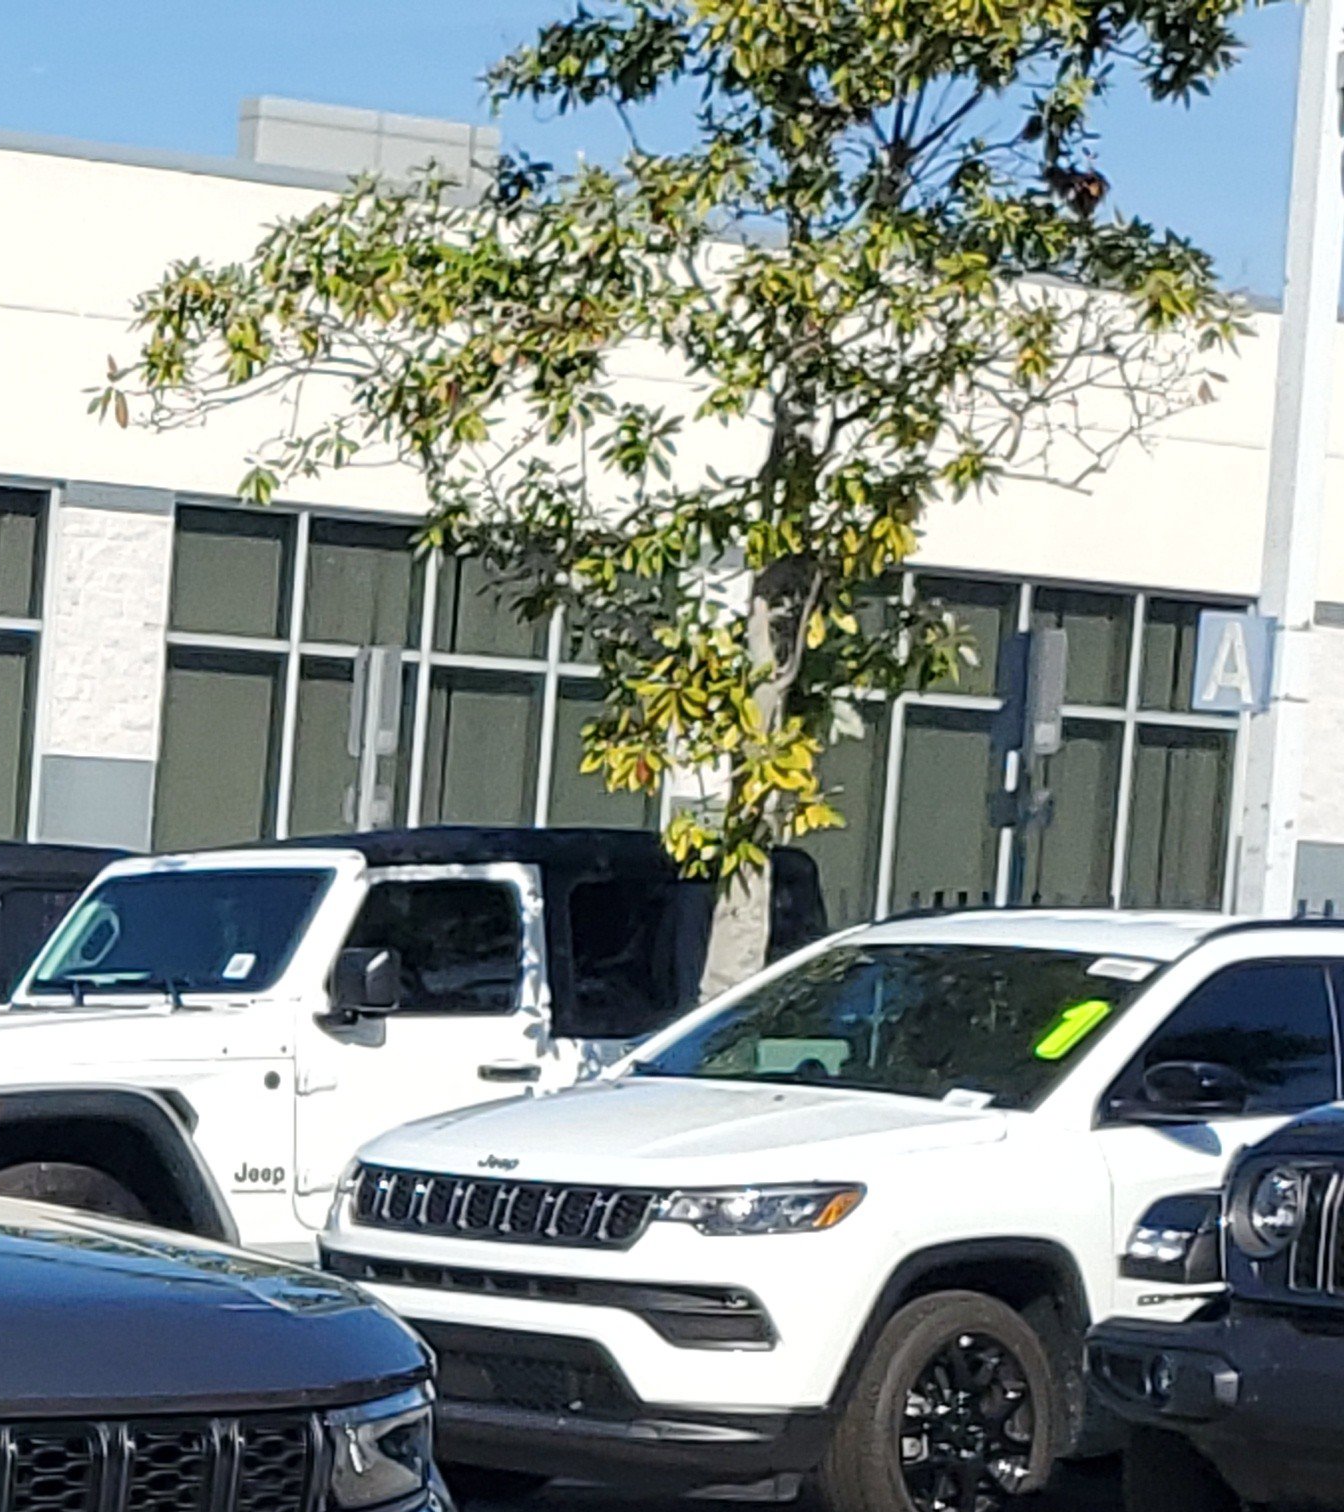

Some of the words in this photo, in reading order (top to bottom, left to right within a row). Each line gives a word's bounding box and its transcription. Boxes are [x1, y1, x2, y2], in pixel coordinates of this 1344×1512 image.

[1201, 621, 1253, 703] A
[233, 1161, 286, 1186] Jeep
[477, 1153, 520, 1172] Jeep
